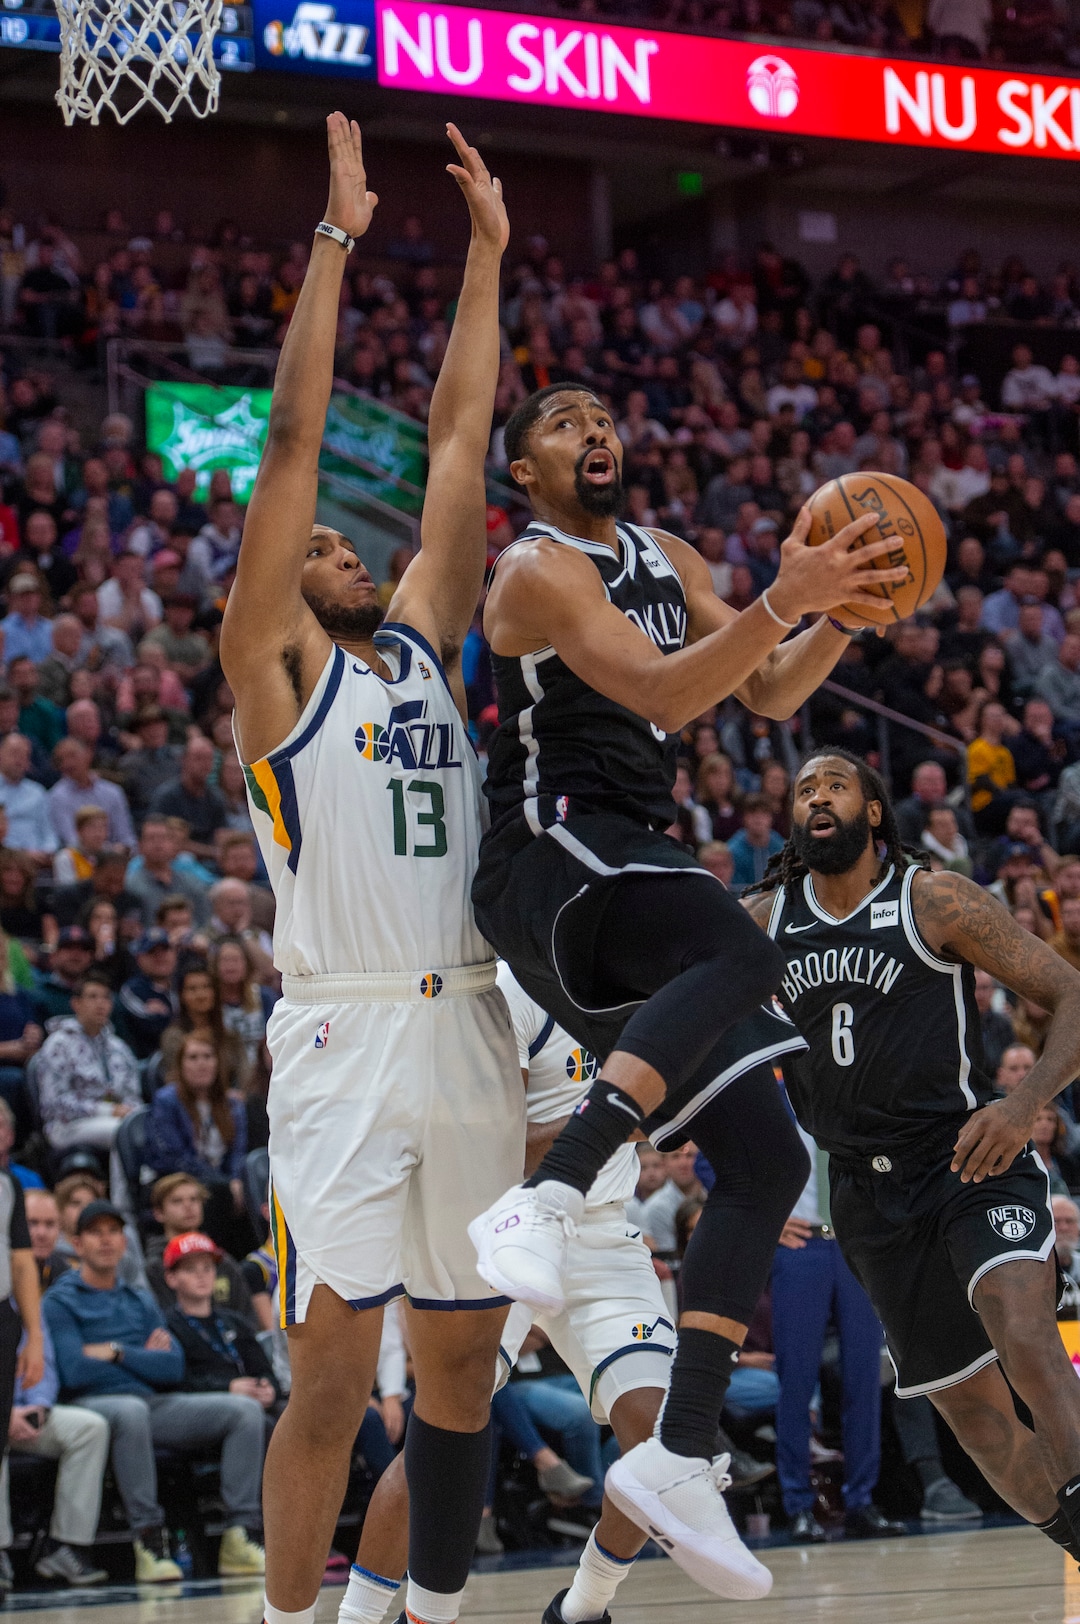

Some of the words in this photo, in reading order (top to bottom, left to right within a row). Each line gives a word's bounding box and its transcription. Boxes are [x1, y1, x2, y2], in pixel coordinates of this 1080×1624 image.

[382, 8, 484, 86] NU
[883, 66, 977, 142] NU
[852, 487, 915, 591] SPALING
[355, 700, 462, 769] JAZZ
[386, 777, 448, 857] 13
[872, 908, 897, 920] infor
[781, 947, 904, 1003] BROOKLYN
[831, 1002, 855, 1067] 6
[990, 1206, 1034, 1226] NETS
